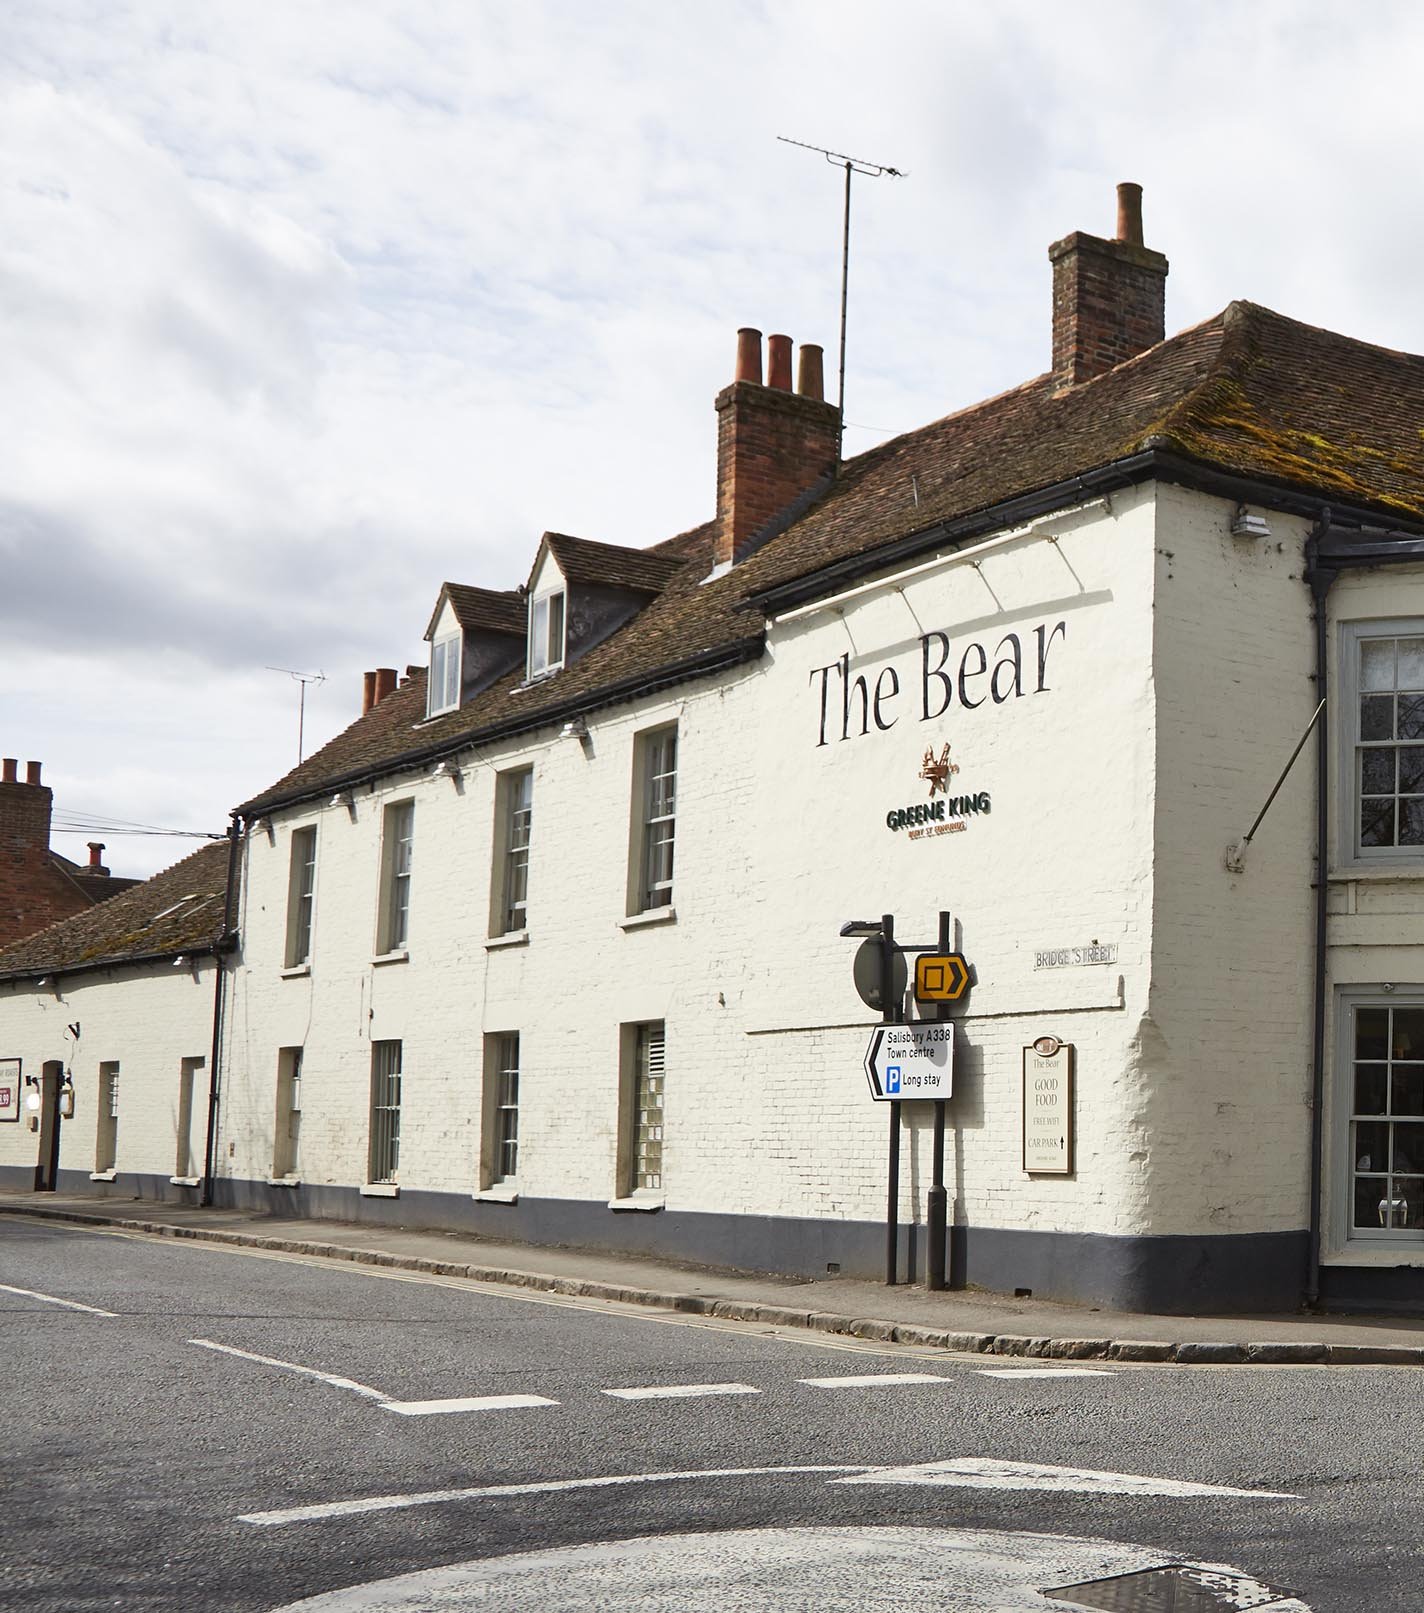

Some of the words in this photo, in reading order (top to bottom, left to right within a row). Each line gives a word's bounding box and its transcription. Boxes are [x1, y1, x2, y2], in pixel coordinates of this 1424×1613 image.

[808, 651, 900, 748] The
[918, 620, 1067, 722] Bear
[886, 800, 946, 831] GREENE
[948, 791, 991, 816] KING
[1036, 950, 1070, 967] BRIDGE
[1074, 945, 1113, 964] STREET
[887, 1031, 925, 1046] Salisbury
[926, 1028, 951, 1042] A338
[887, 1047, 907, 1059] Town
[908, 1046, 935, 1059] centre
[1033, 1058, 1045, 1069] The
[1045, 1058, 1060, 1069] Bear
[902, 1073, 922, 1088] Long
[923, 1072, 942, 1087] stay
[1035, 1078, 1058, 1091] GOOD
[1035, 1094, 1058, 1106] FOOD
[1028, 1138, 1041, 1148] CAR
[1041, 1137, 1058, 1148] PARK
